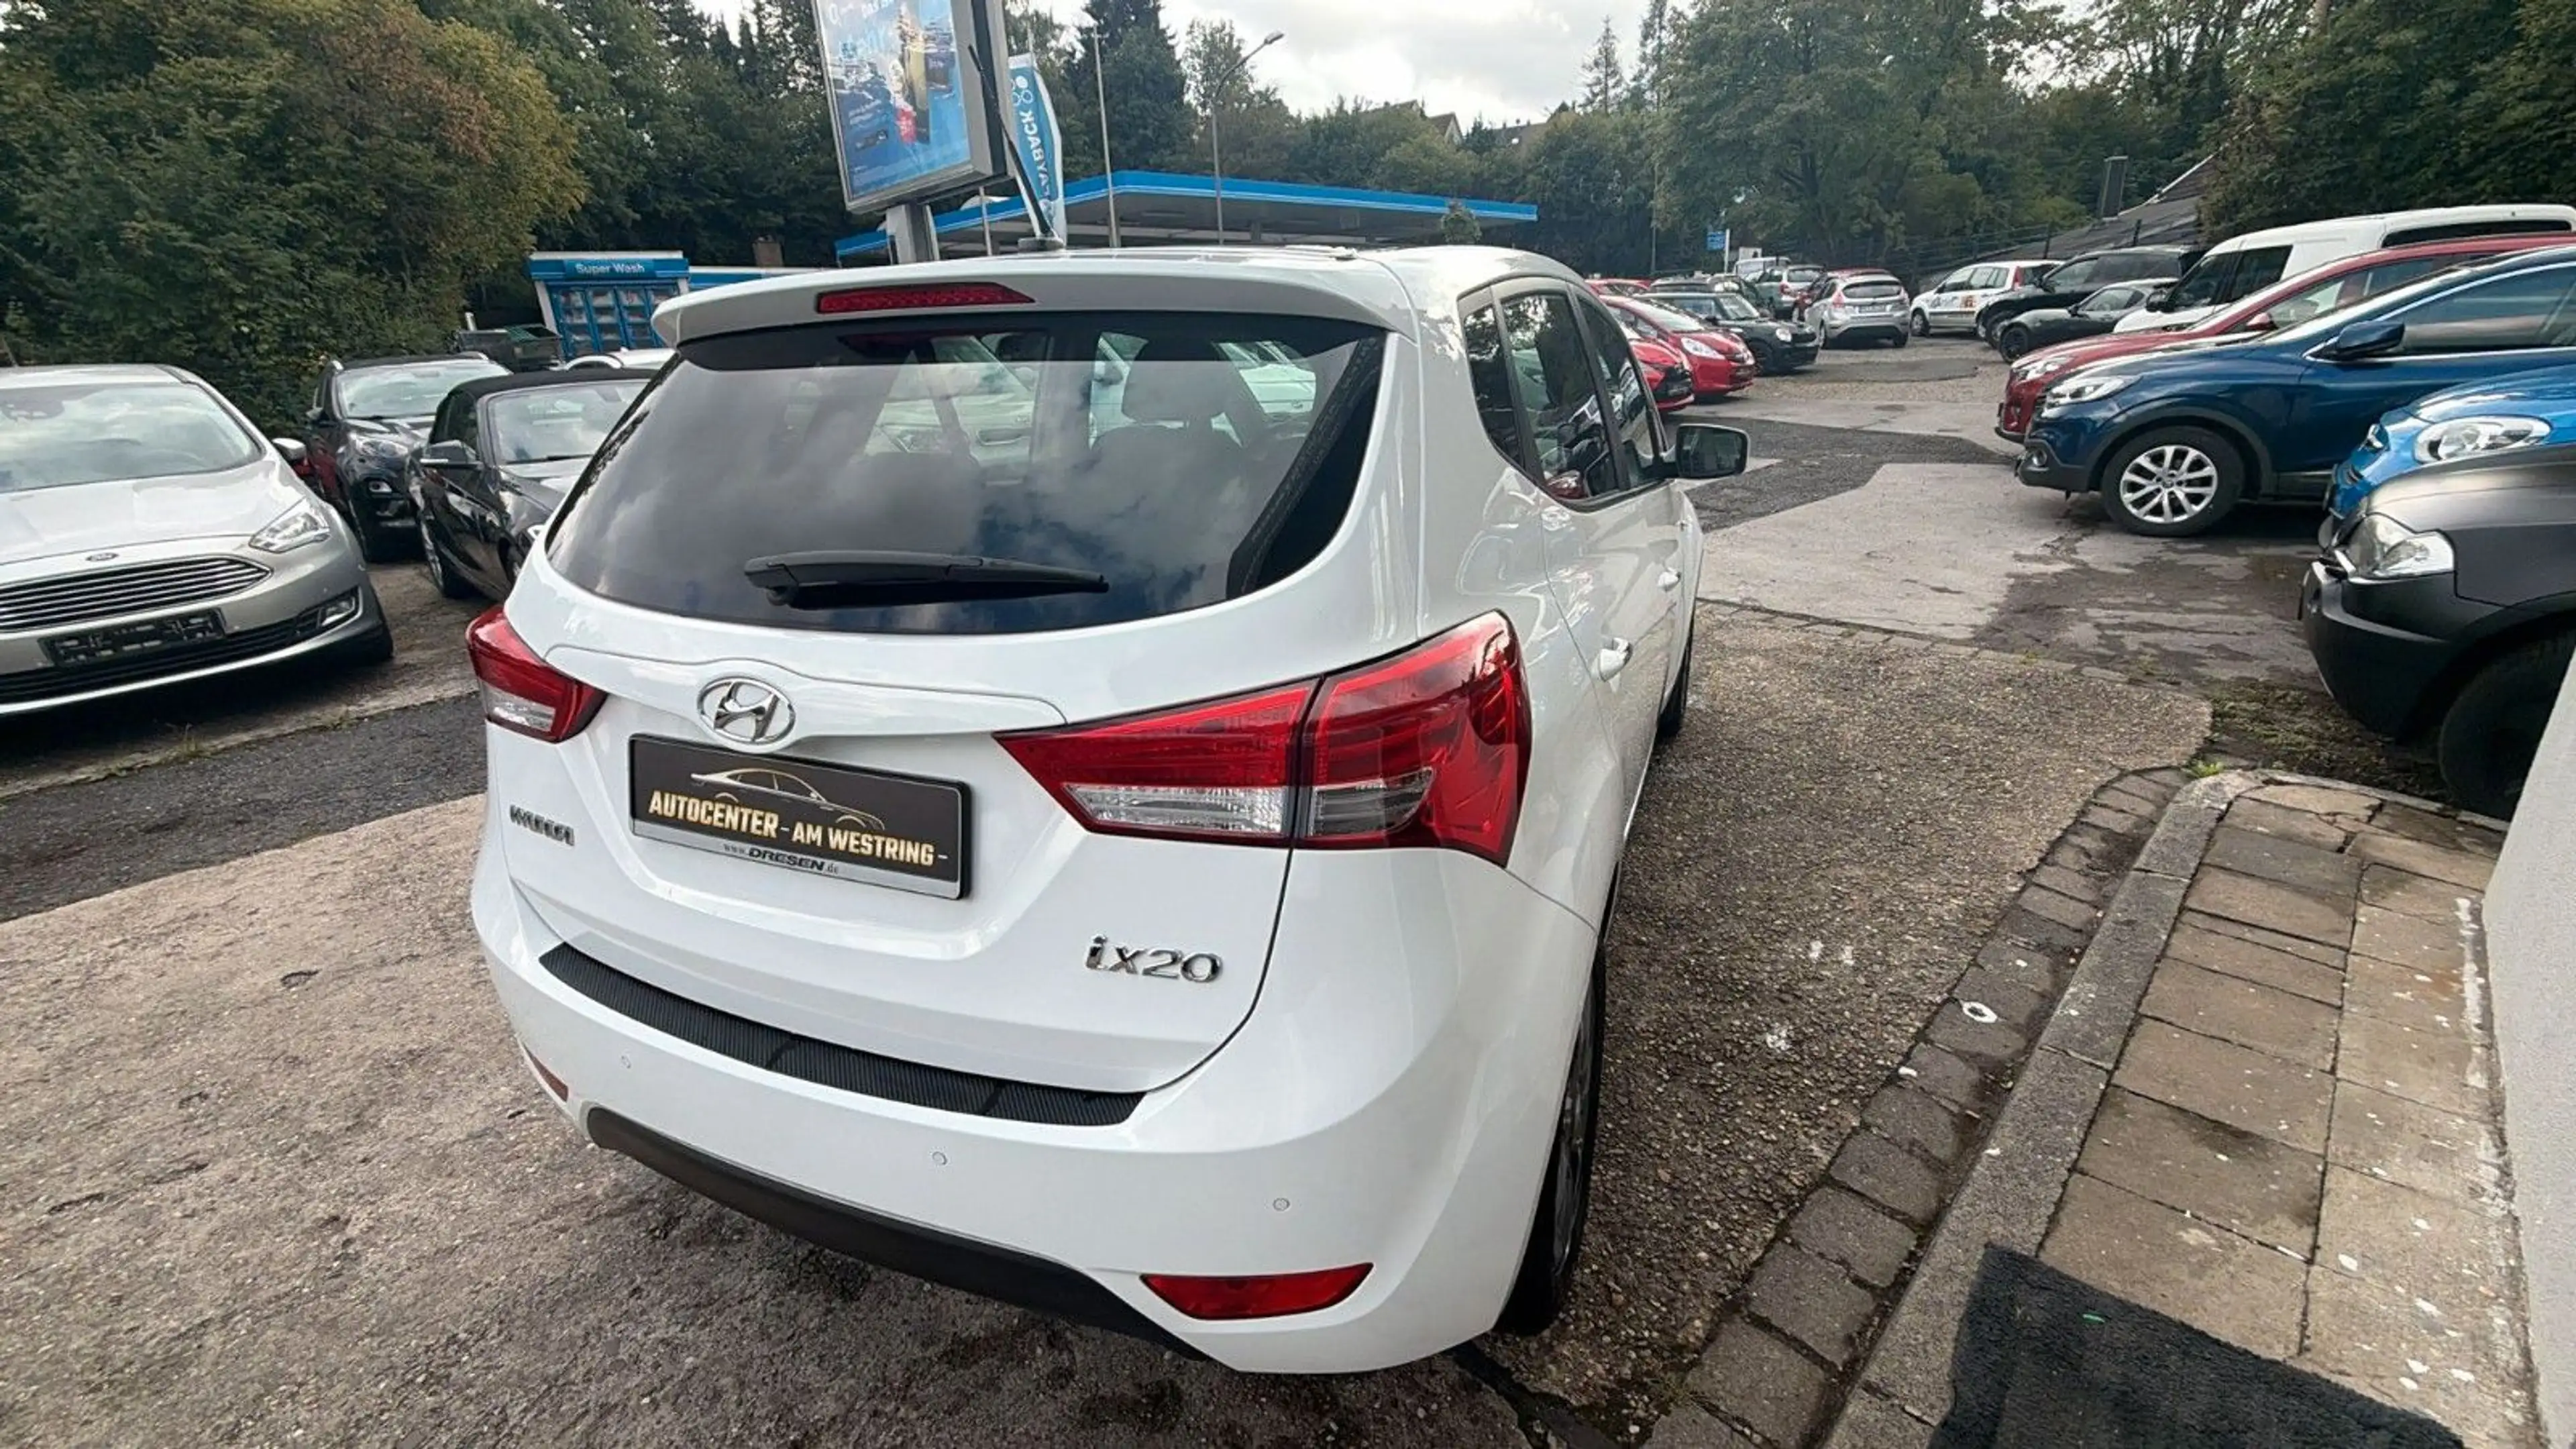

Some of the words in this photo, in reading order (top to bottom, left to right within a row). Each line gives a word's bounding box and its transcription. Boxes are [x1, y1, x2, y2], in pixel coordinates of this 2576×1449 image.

[576, 262, 610, 276] Super
[611, 262, 645, 274] Wash
[648, 790, 779, 839] AUTOCENTER
[792, 820, 823, 847] AM
[828, 826, 936, 867] WESTRING
[1085, 935, 1224, 983] ix20
